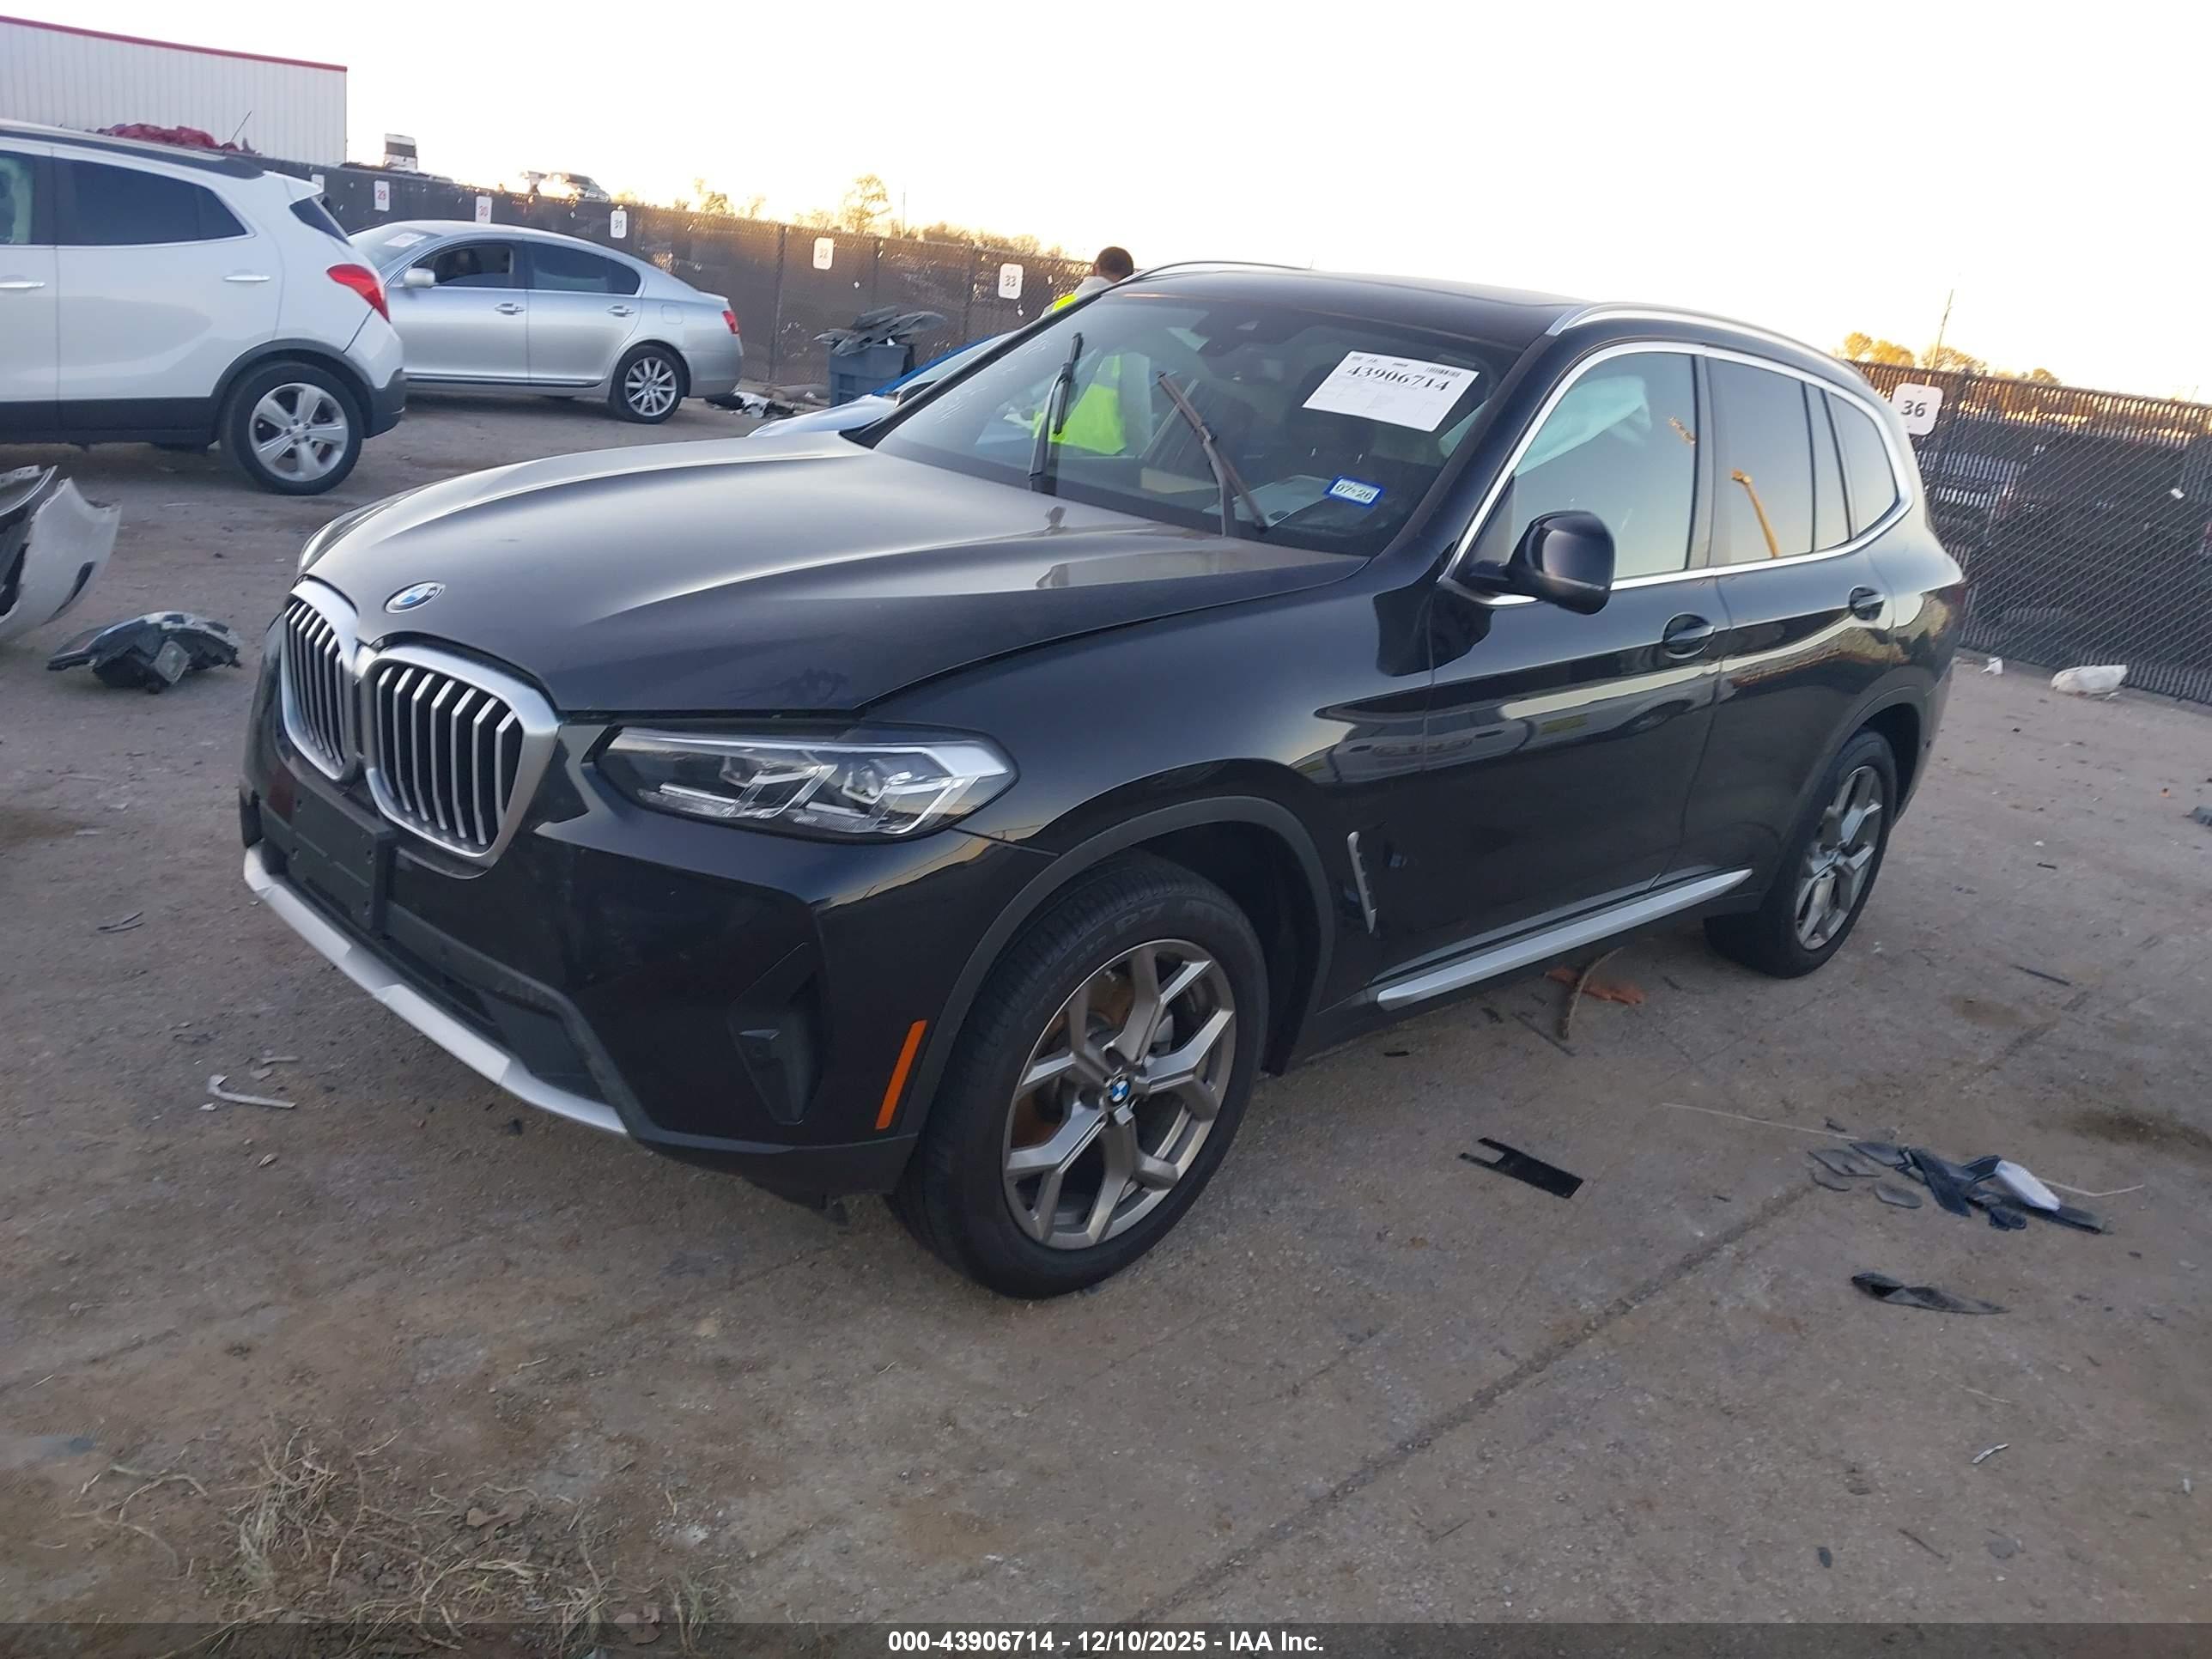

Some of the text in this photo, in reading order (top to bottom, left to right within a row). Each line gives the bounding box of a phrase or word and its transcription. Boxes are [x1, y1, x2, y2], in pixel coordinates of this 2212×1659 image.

[1004, 275, 1017, 288] 33
[1346, 365, 1451, 392] 43906714
[1900, 399, 1928, 417] 36
